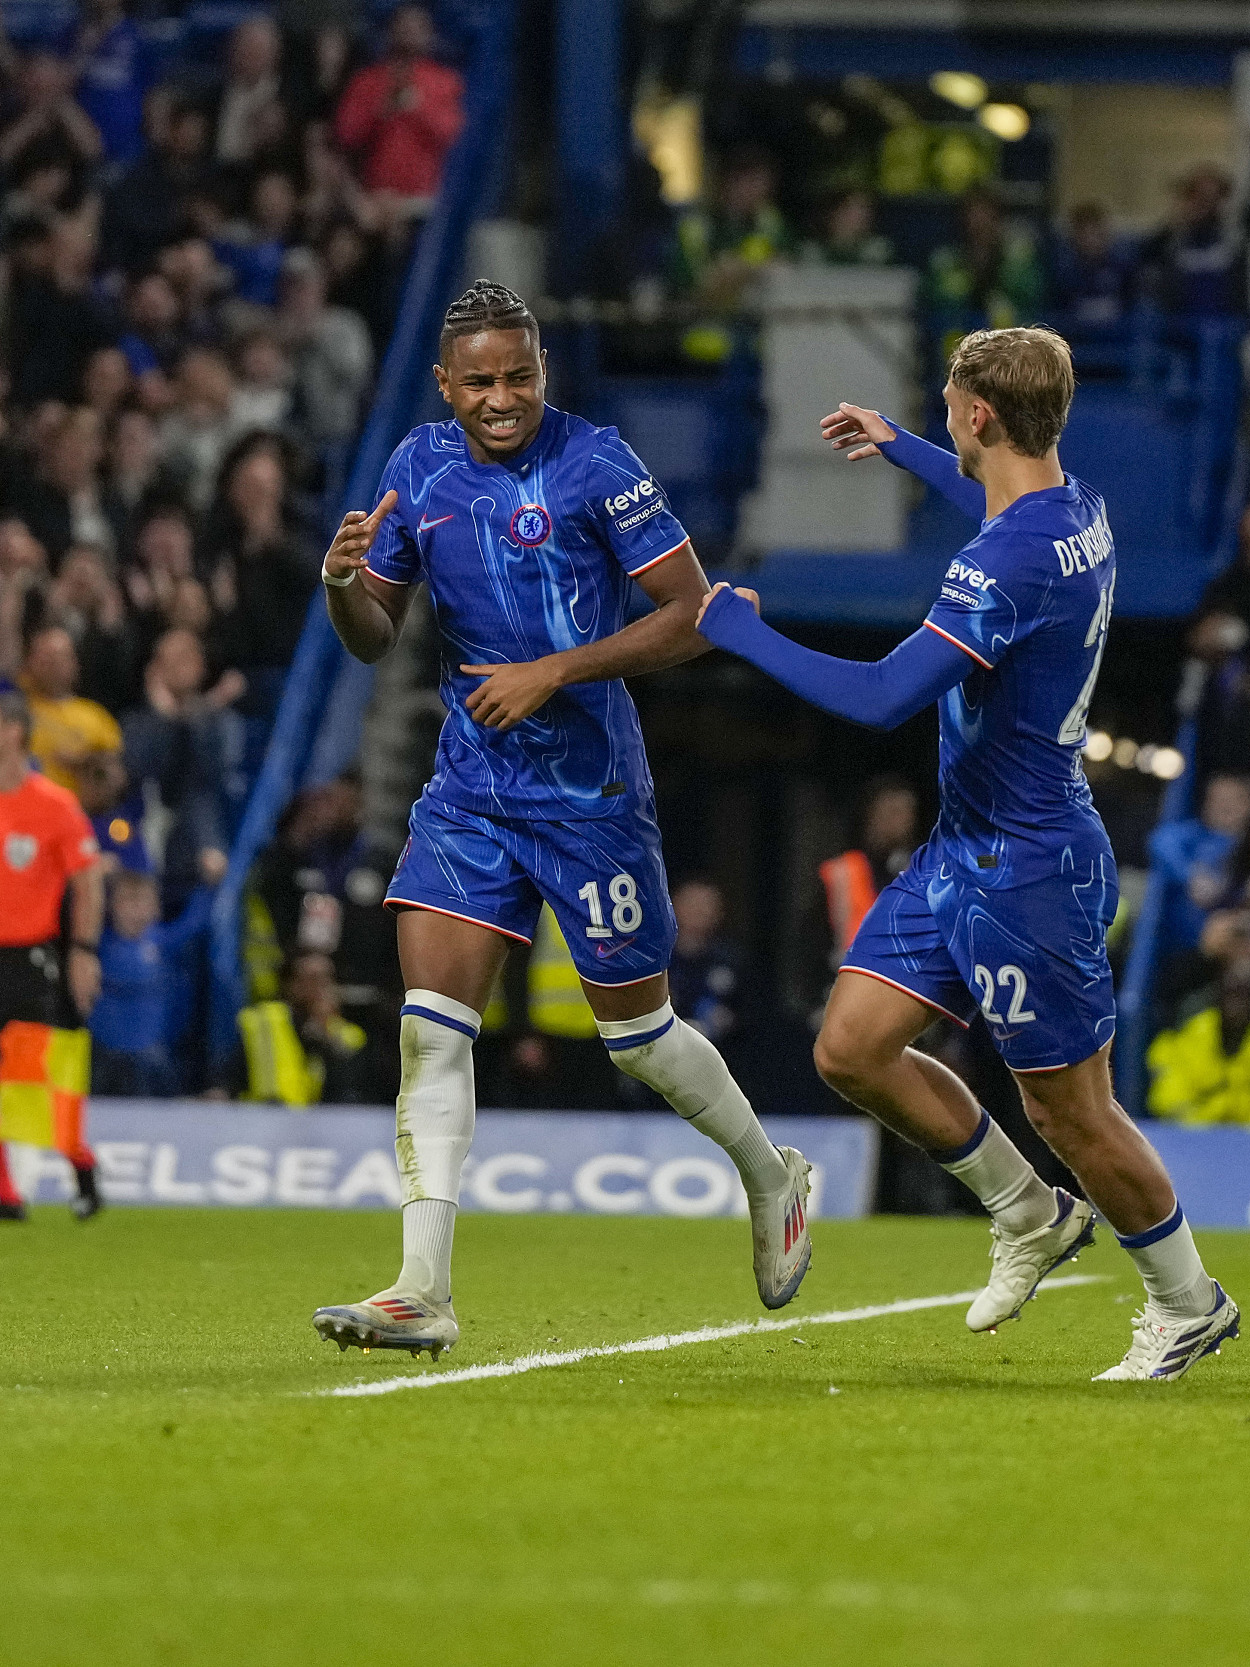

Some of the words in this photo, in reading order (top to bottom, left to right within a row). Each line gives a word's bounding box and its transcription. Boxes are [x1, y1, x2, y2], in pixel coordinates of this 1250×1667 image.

[604, 475, 655, 517] feve
[945, 561, 997, 592] ever
[577, 873, 643, 938] 18
[974, 963, 1037, 1024] 22
